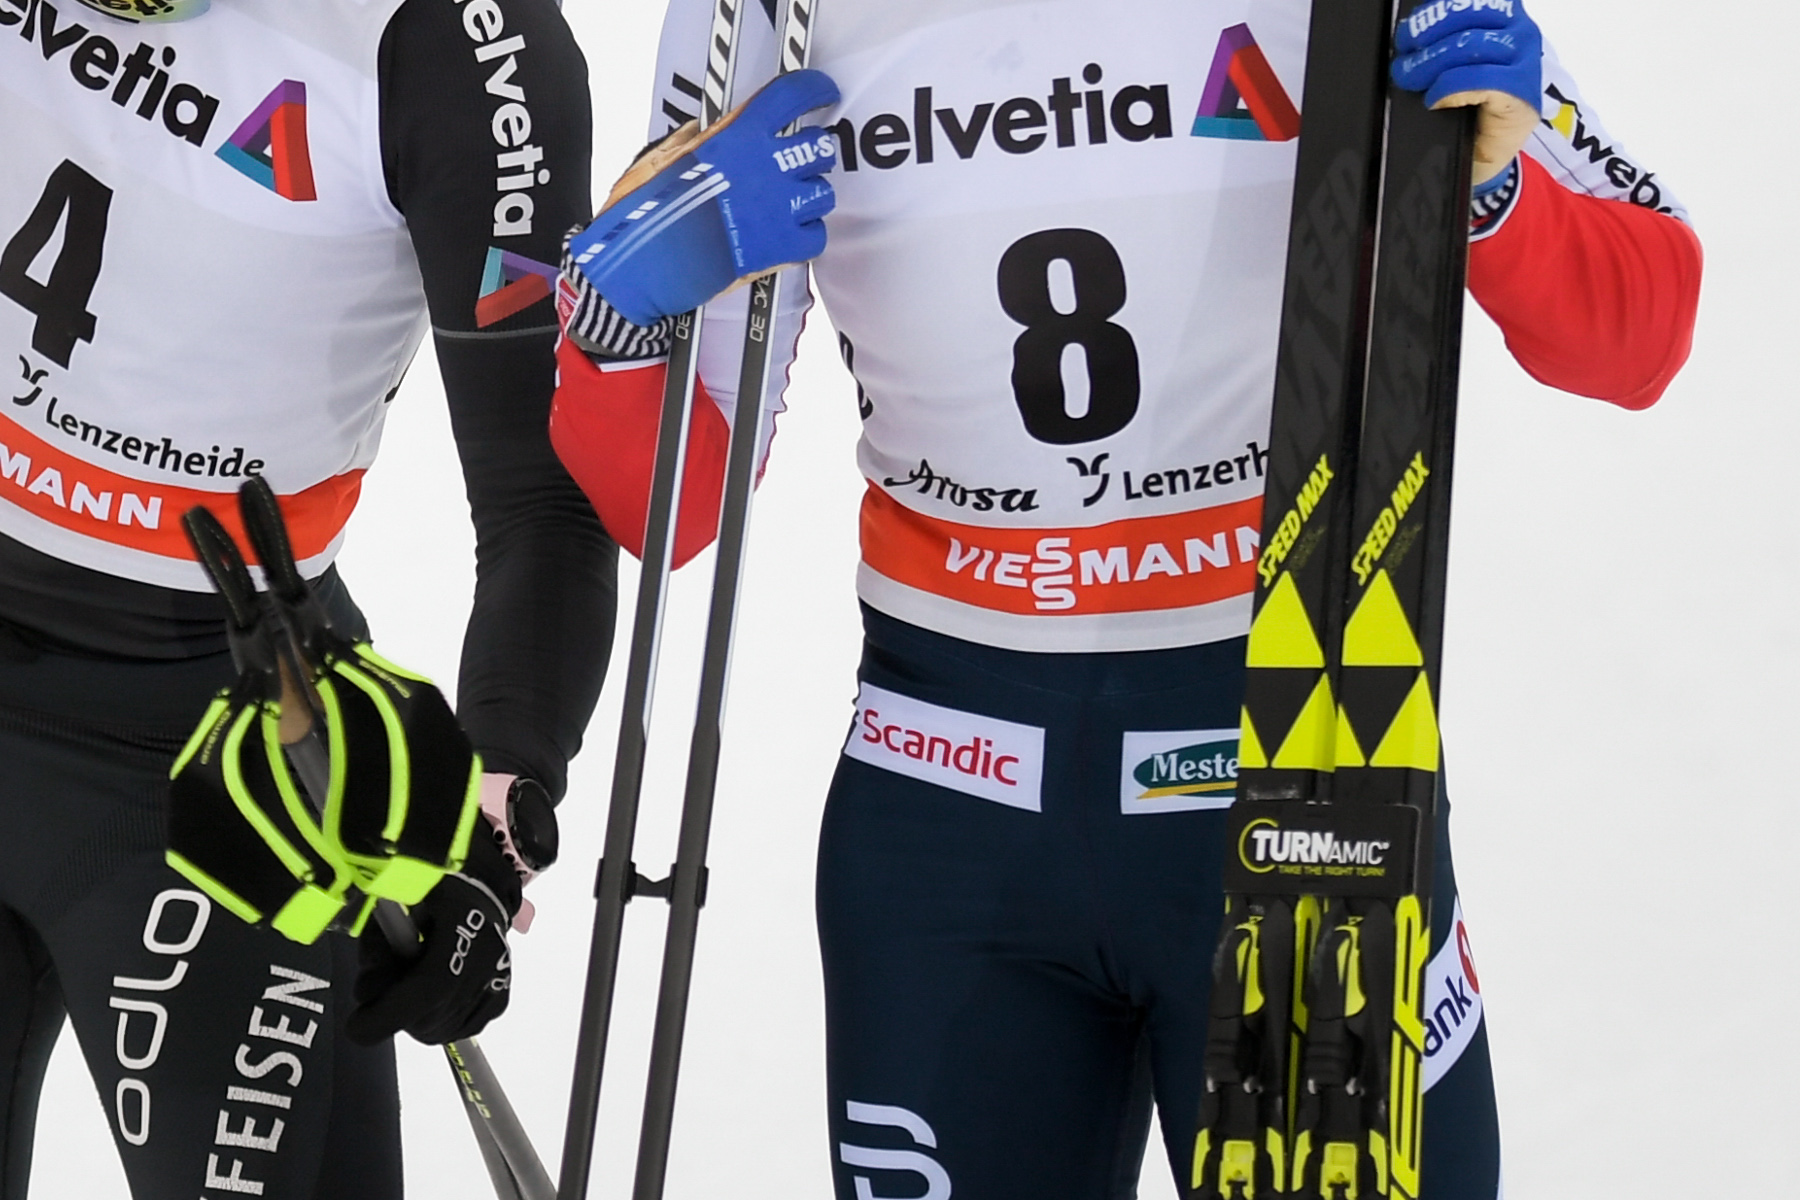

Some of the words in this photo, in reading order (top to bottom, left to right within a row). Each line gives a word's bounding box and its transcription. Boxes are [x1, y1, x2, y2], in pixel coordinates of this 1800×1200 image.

[996, 226, 1142, 446] 8
[45, 396, 266, 479] Lenzerheide
[883, 458, 1040, 514] Arosa
[1123, 441, 1270, 502] Lenzerh
[862, 708, 1020, 788] Scandic
[1251, 829, 1385, 866] TURNAMIC
[449, 908, 486, 976] odlo
[108, 888, 212, 1146] odlo
